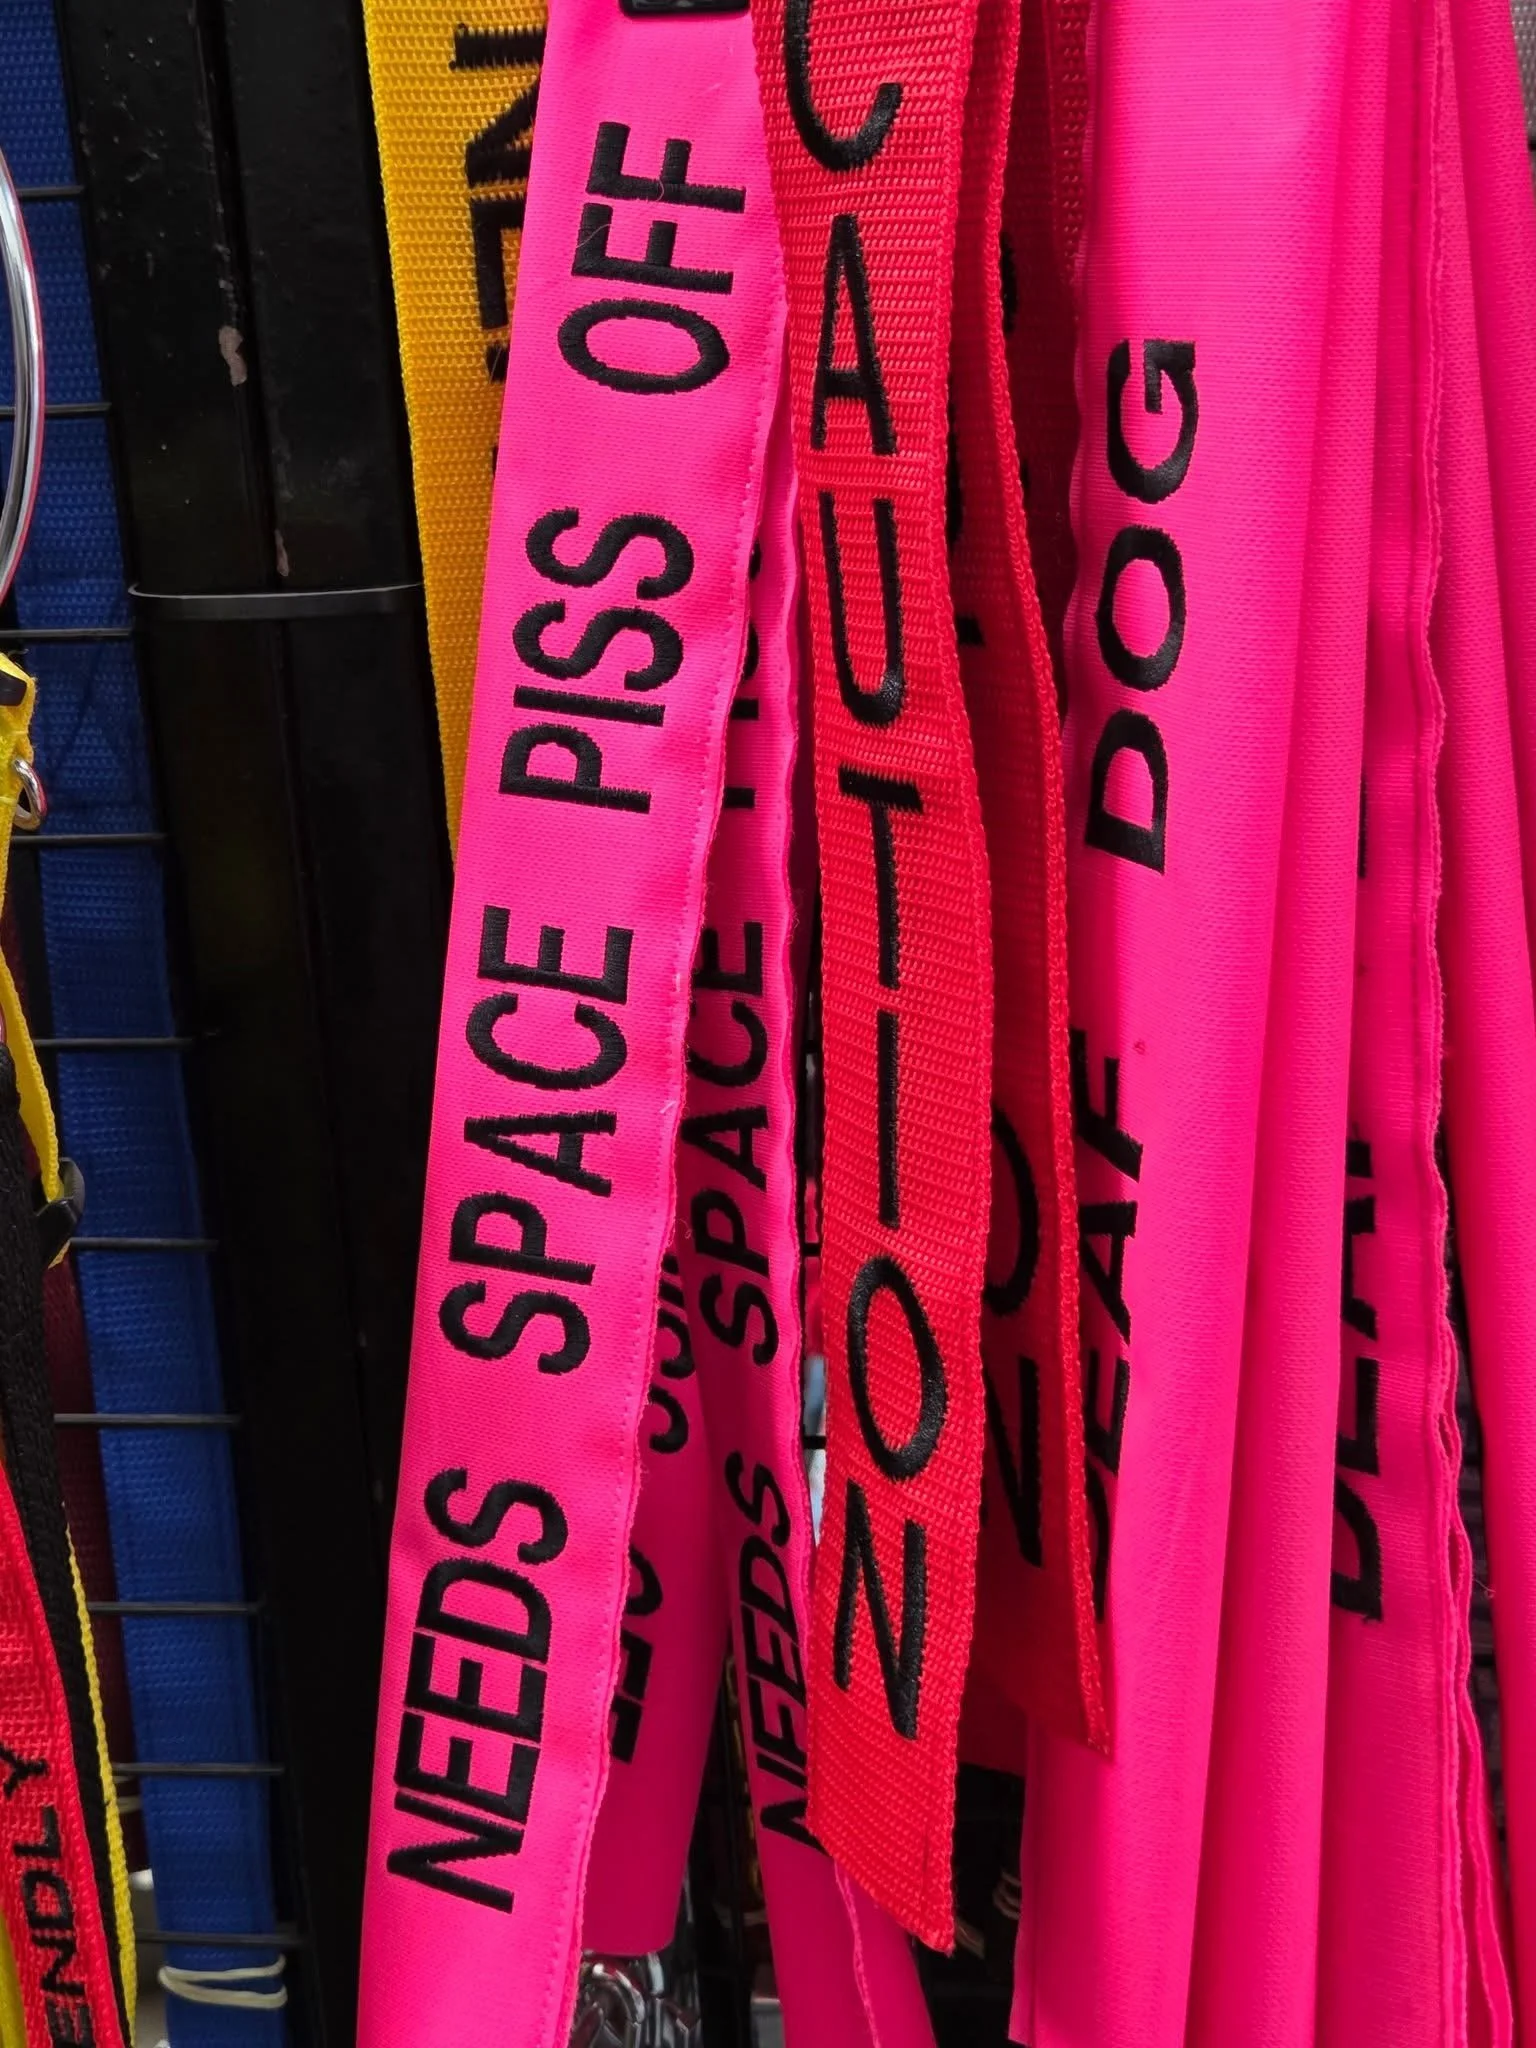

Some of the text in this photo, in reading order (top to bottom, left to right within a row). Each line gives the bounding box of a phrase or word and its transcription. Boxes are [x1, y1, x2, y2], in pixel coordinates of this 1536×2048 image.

[557, 121, 746, 395] OFF
[498, 506, 694, 815] PISS
[1083, 338, 1199, 876] DOG
[783, 0, 948, 1739] CAUTION
[439, 904, 634, 1376] SPACE
[387, 1468, 569, 1914] NEEDS
